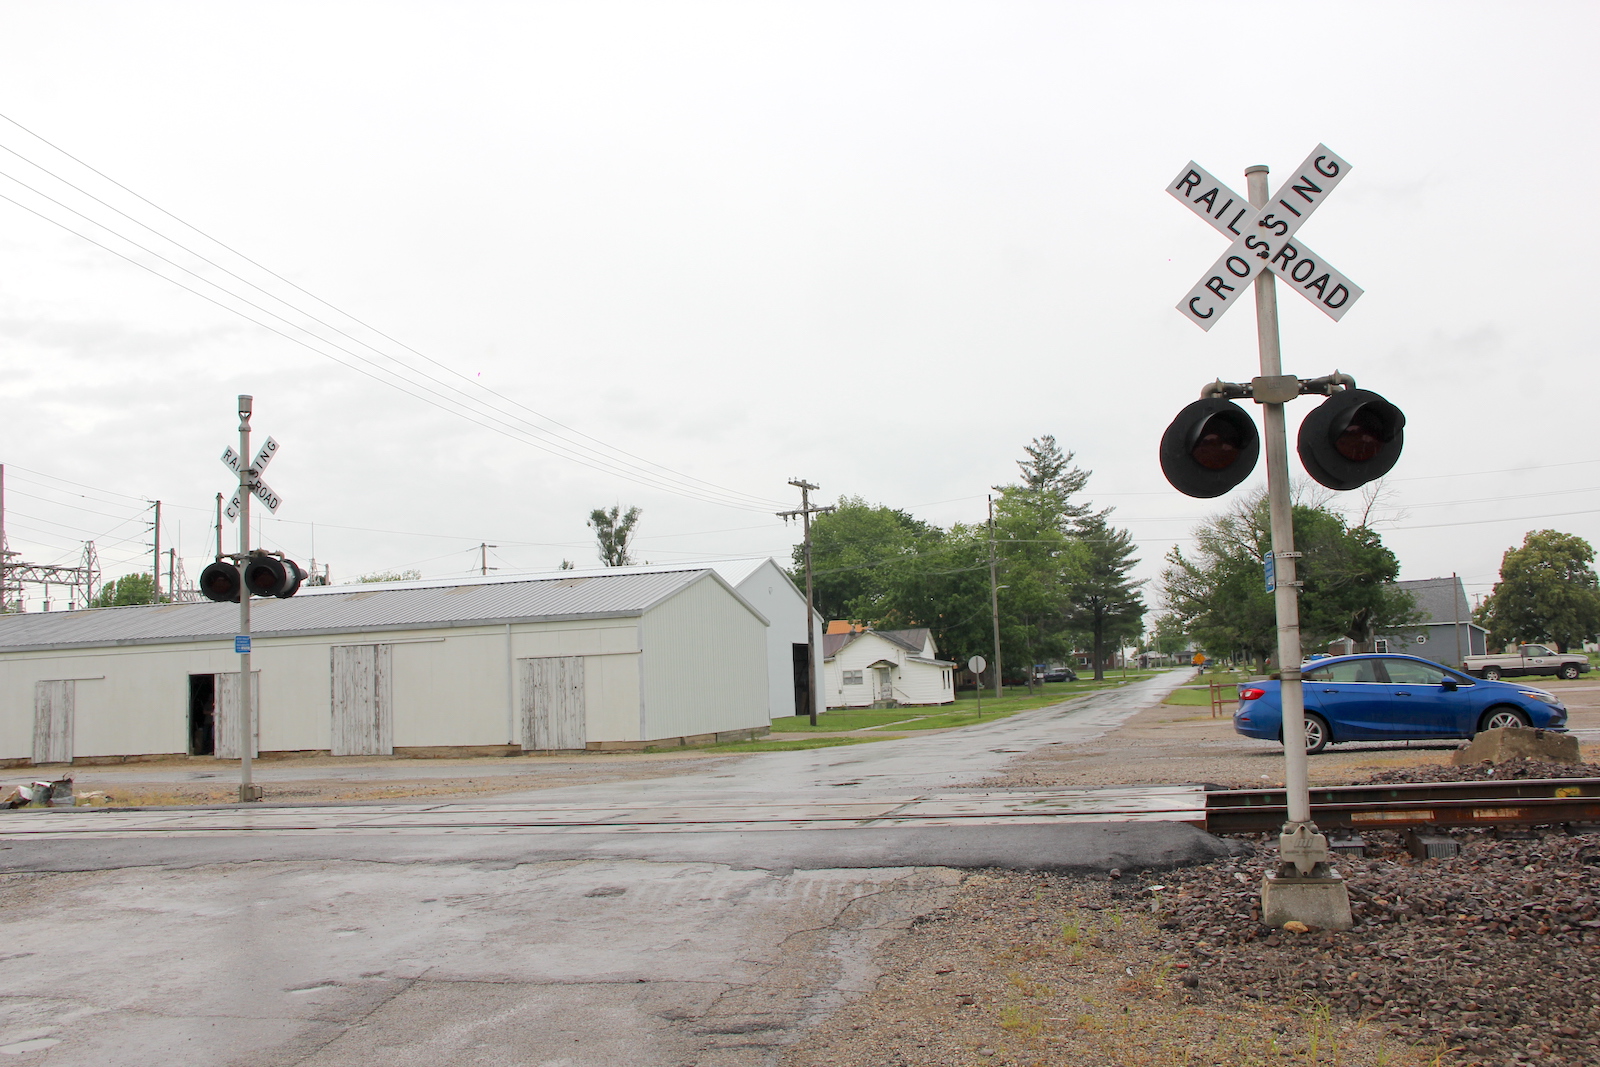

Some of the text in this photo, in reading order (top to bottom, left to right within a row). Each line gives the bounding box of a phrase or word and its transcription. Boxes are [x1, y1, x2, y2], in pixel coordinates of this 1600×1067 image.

[1175, 169, 1349, 309] RAIL ROAD
[1188, 155, 1340, 319] CROSSING
[223, 449, 278, 510] RAI ROAD
